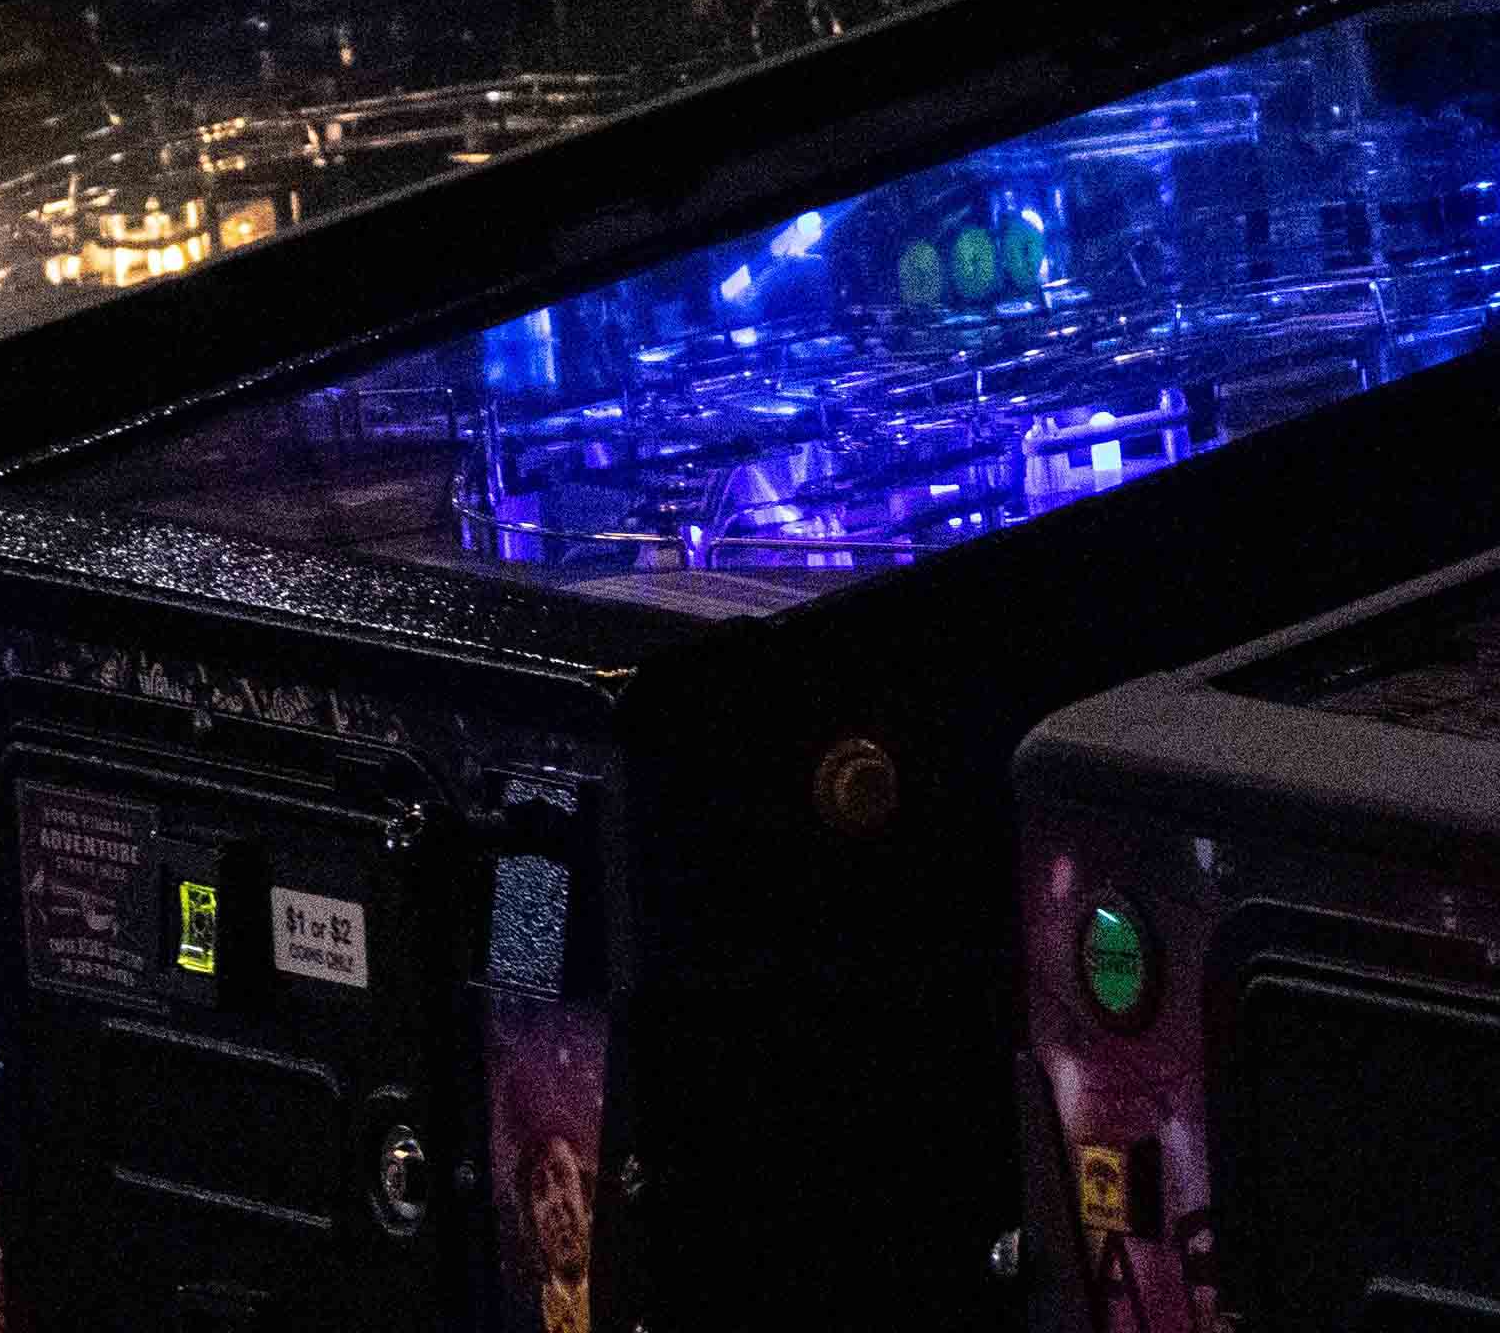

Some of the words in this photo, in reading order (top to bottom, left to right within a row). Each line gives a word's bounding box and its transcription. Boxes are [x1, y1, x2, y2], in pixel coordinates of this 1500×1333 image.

[39, 826, 142, 867] ADVENTURE
[286, 904, 306, 937] $1
[310, 920, 327, 940] or
[329, 913, 352, 947] $2
